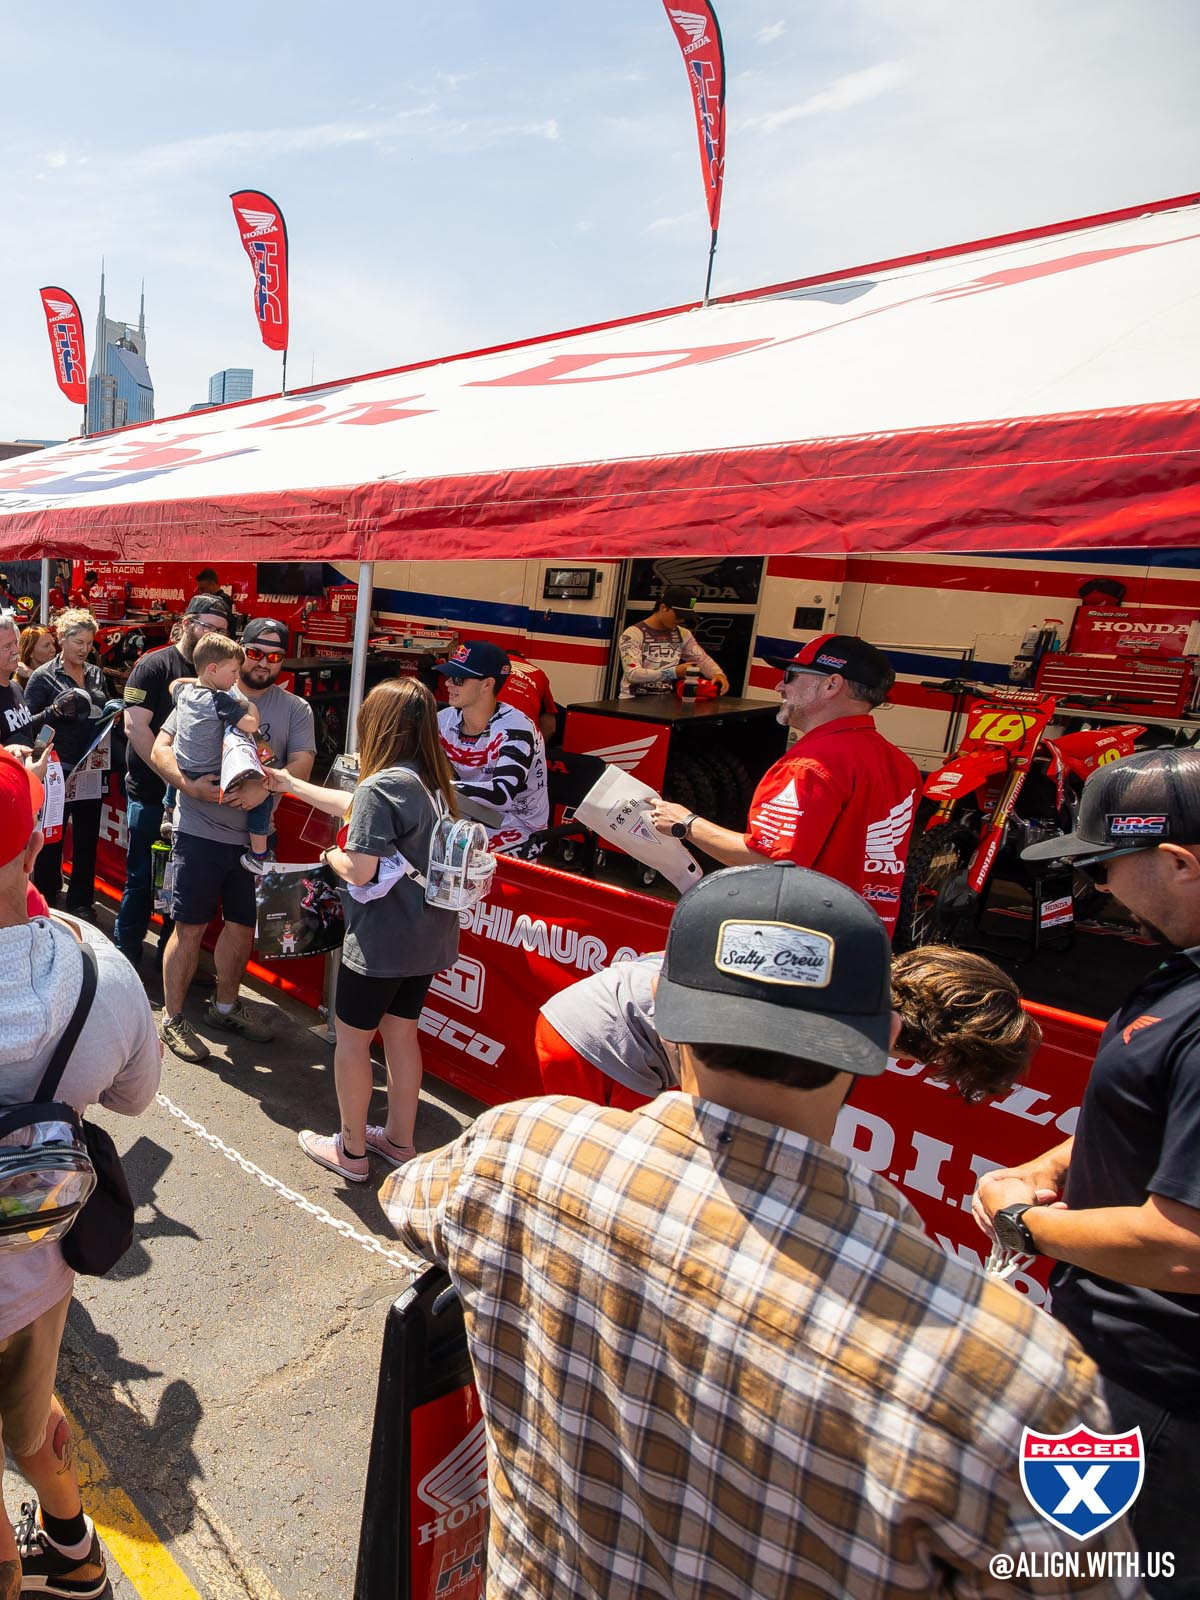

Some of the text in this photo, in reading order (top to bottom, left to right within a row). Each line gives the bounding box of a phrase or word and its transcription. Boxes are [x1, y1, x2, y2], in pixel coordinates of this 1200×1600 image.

[683, 36, 711, 55] HONDA
[243, 225, 278, 239] HONDA
[49, 312, 75, 322] HONDA
[112, 566, 144, 574] RACING
[649, 585, 740, 599] HDA
[1091, 621, 1191, 634] HONDA
[969, 713, 1036, 742] 18
[1110, 817, 1166, 831] HRC
[976, 841, 997, 885] DUNLOP
[1044, 902, 1068, 912] HONDA
[723, 949, 824, 970] Salty Crew
